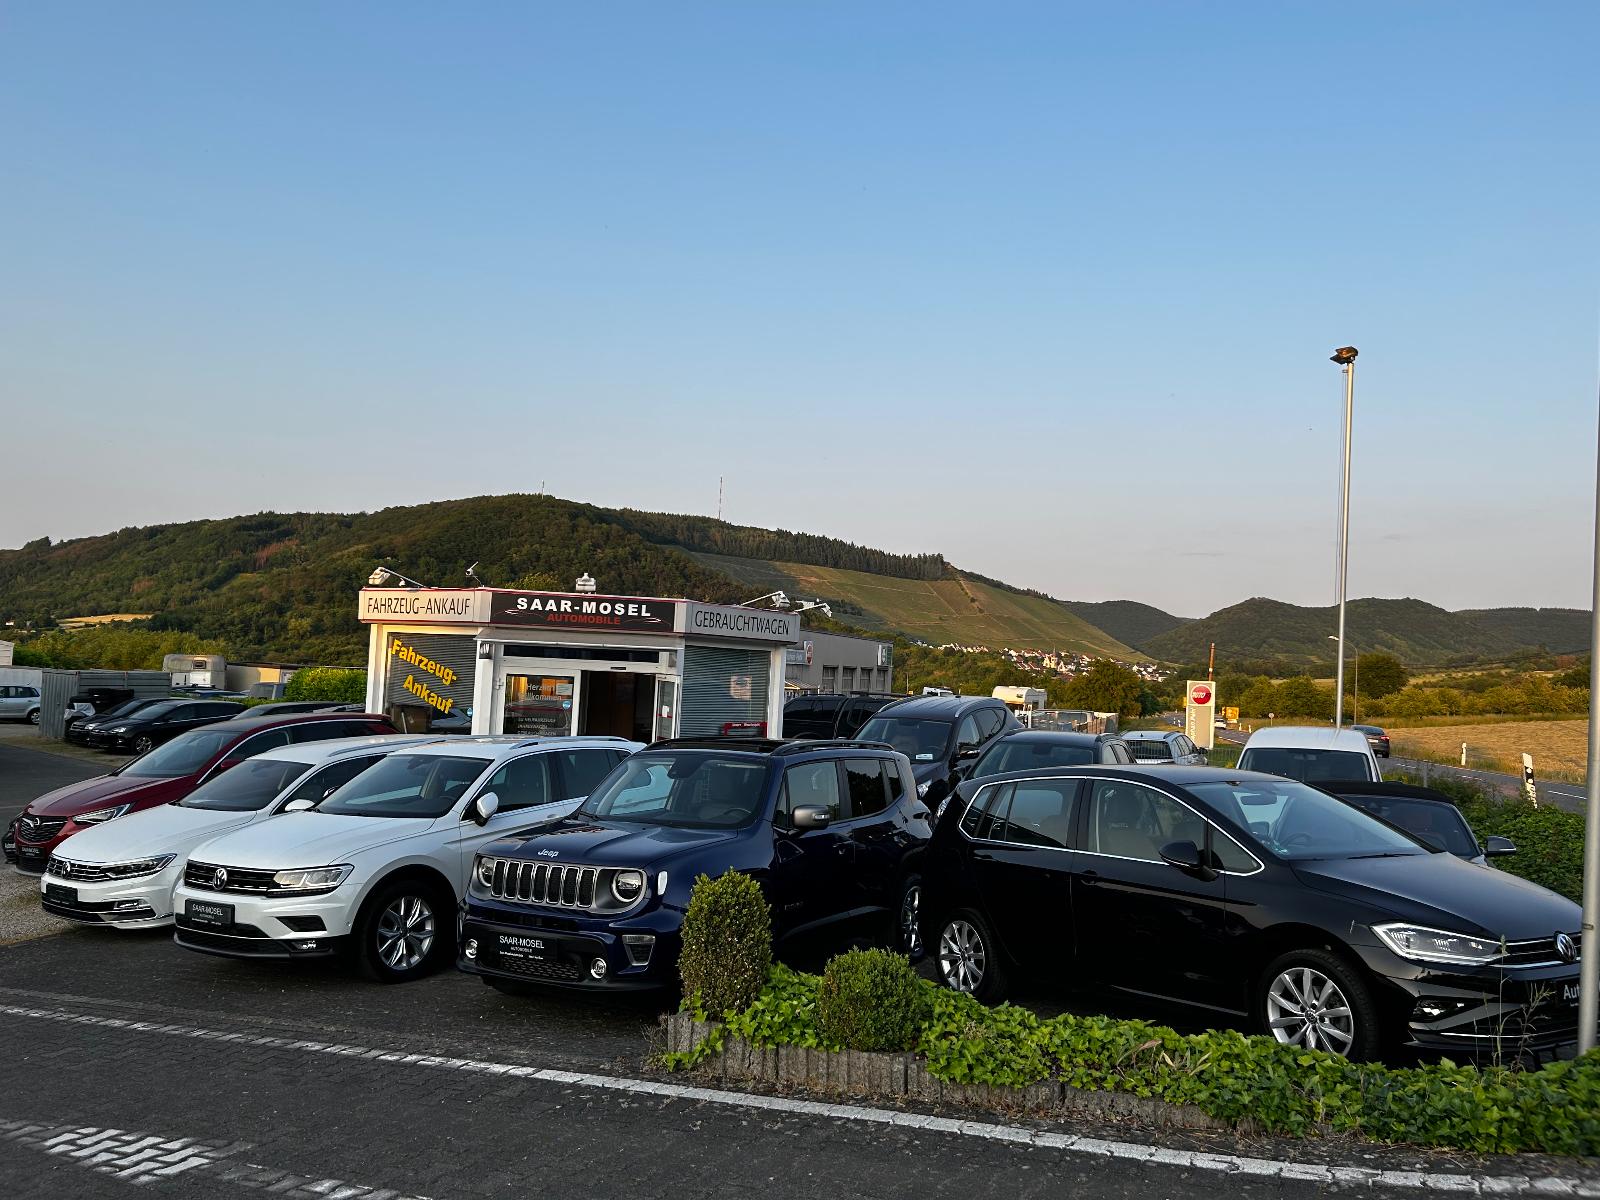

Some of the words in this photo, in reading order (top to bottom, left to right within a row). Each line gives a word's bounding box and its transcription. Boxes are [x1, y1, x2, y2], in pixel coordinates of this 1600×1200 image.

[367, 597, 471, 615] FAHRZEUG-ANKAUF
[516, 597, 651, 617] SAAR-MOSEL
[546, 613, 622, 625] AUTOMOBILE
[694, 610, 790, 636] GEBRAUCHTWAGEN
[390, 639, 457, 685] Fahrzeug-
[403, 674, 454, 714] Ankauf
[537, 849, 559, 858] Jeep
[500, 935, 545, 949] SAAR-MOSEL
